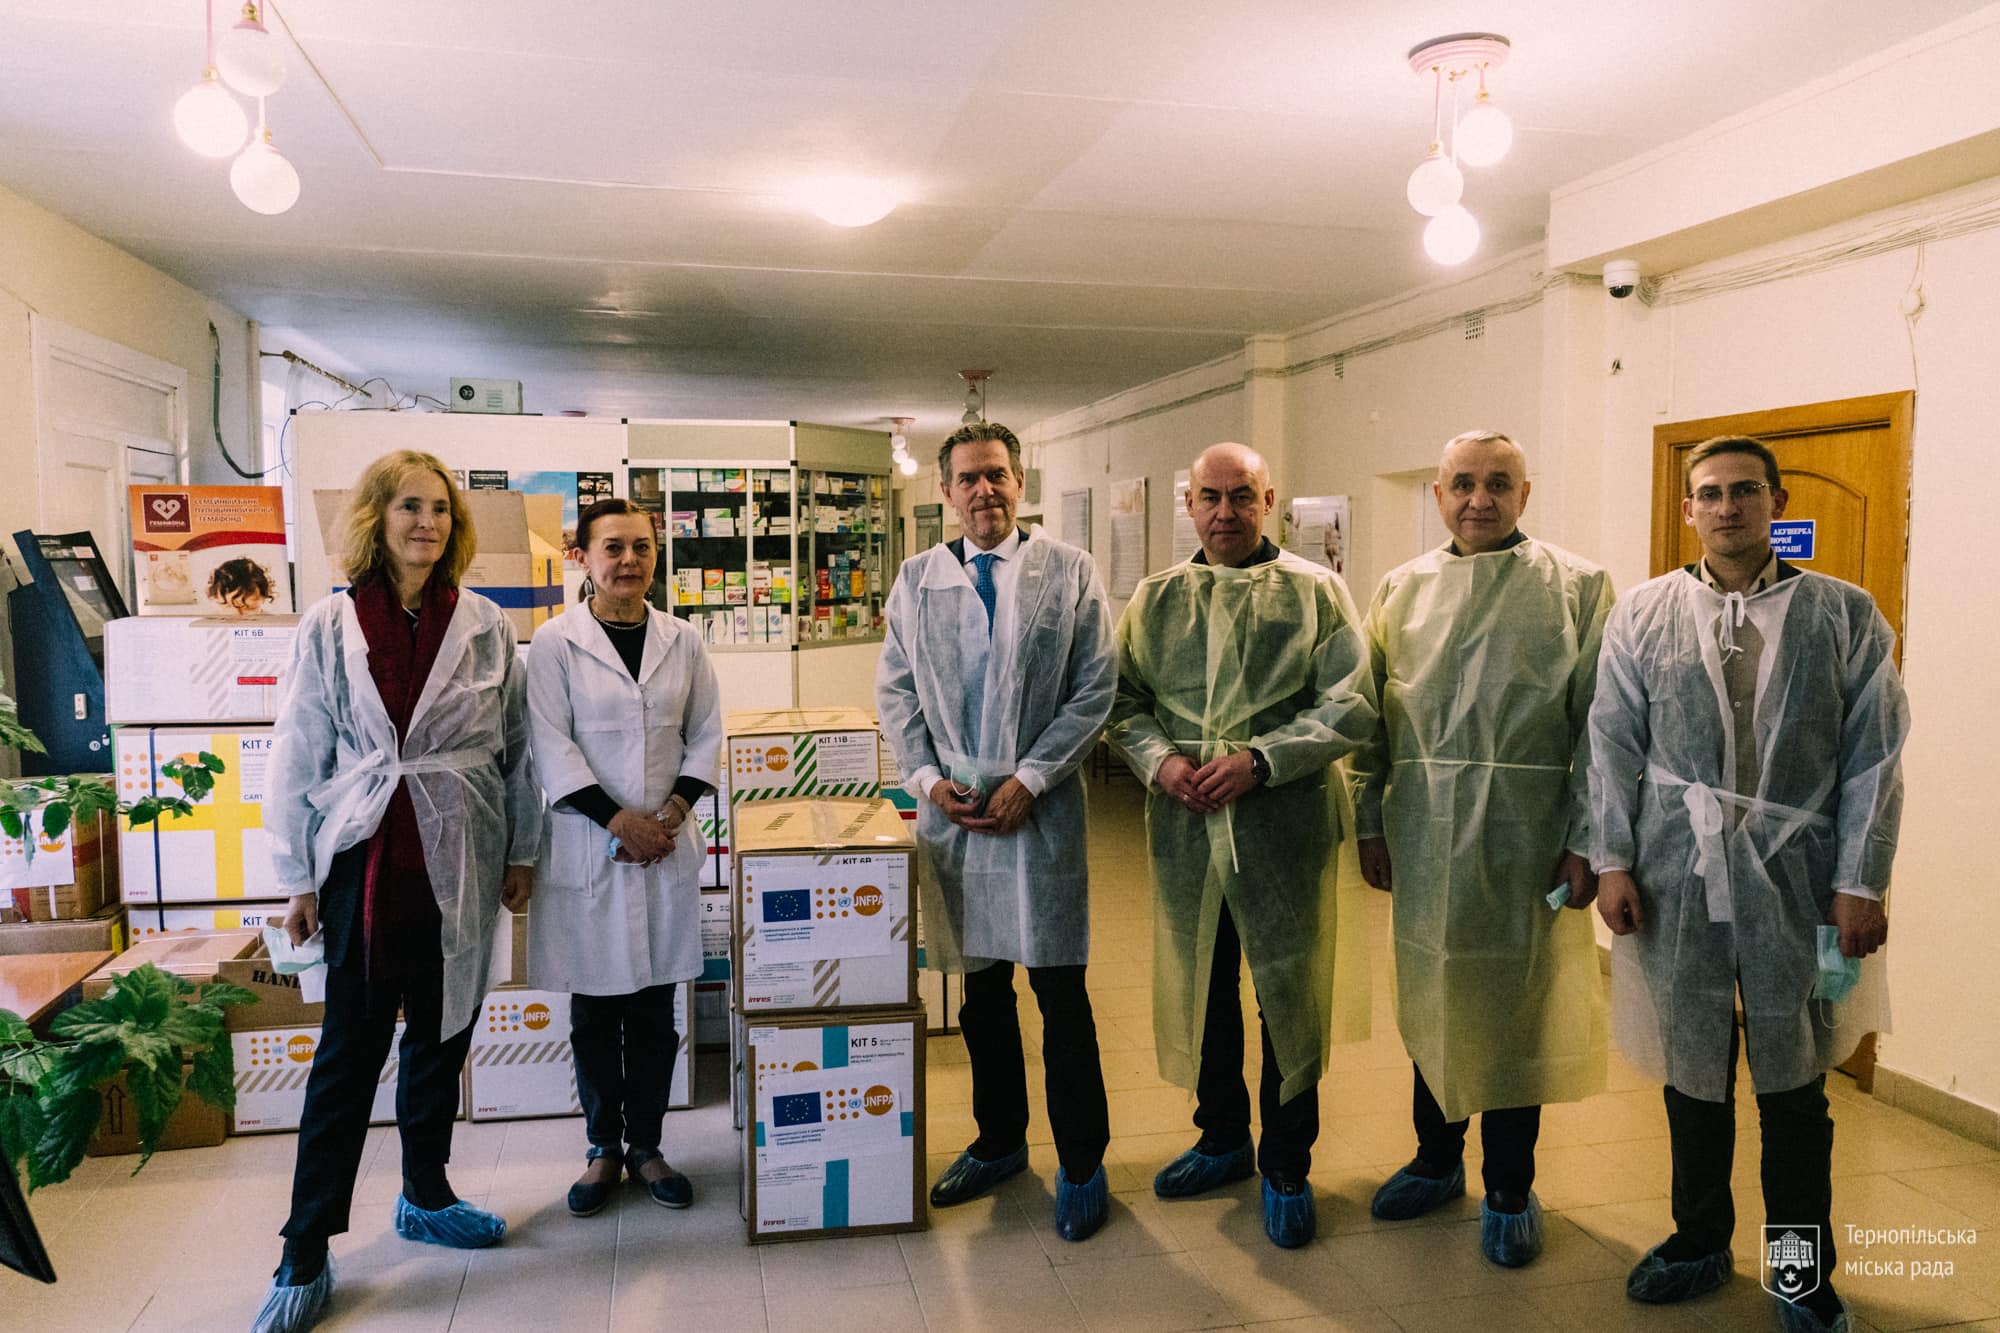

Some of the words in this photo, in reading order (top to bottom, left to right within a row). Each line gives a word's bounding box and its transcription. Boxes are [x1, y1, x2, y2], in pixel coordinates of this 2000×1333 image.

[234, 629, 249, 637] KIT
[242, 739, 262, 749] KIT
[818, 736, 831, 744] KIT
[842, 857, 857, 865] KIT
[243, 916, 262, 927] KIT
[851, 1038, 868, 1048] KIT
[871, 1038, 878, 1047] 5
